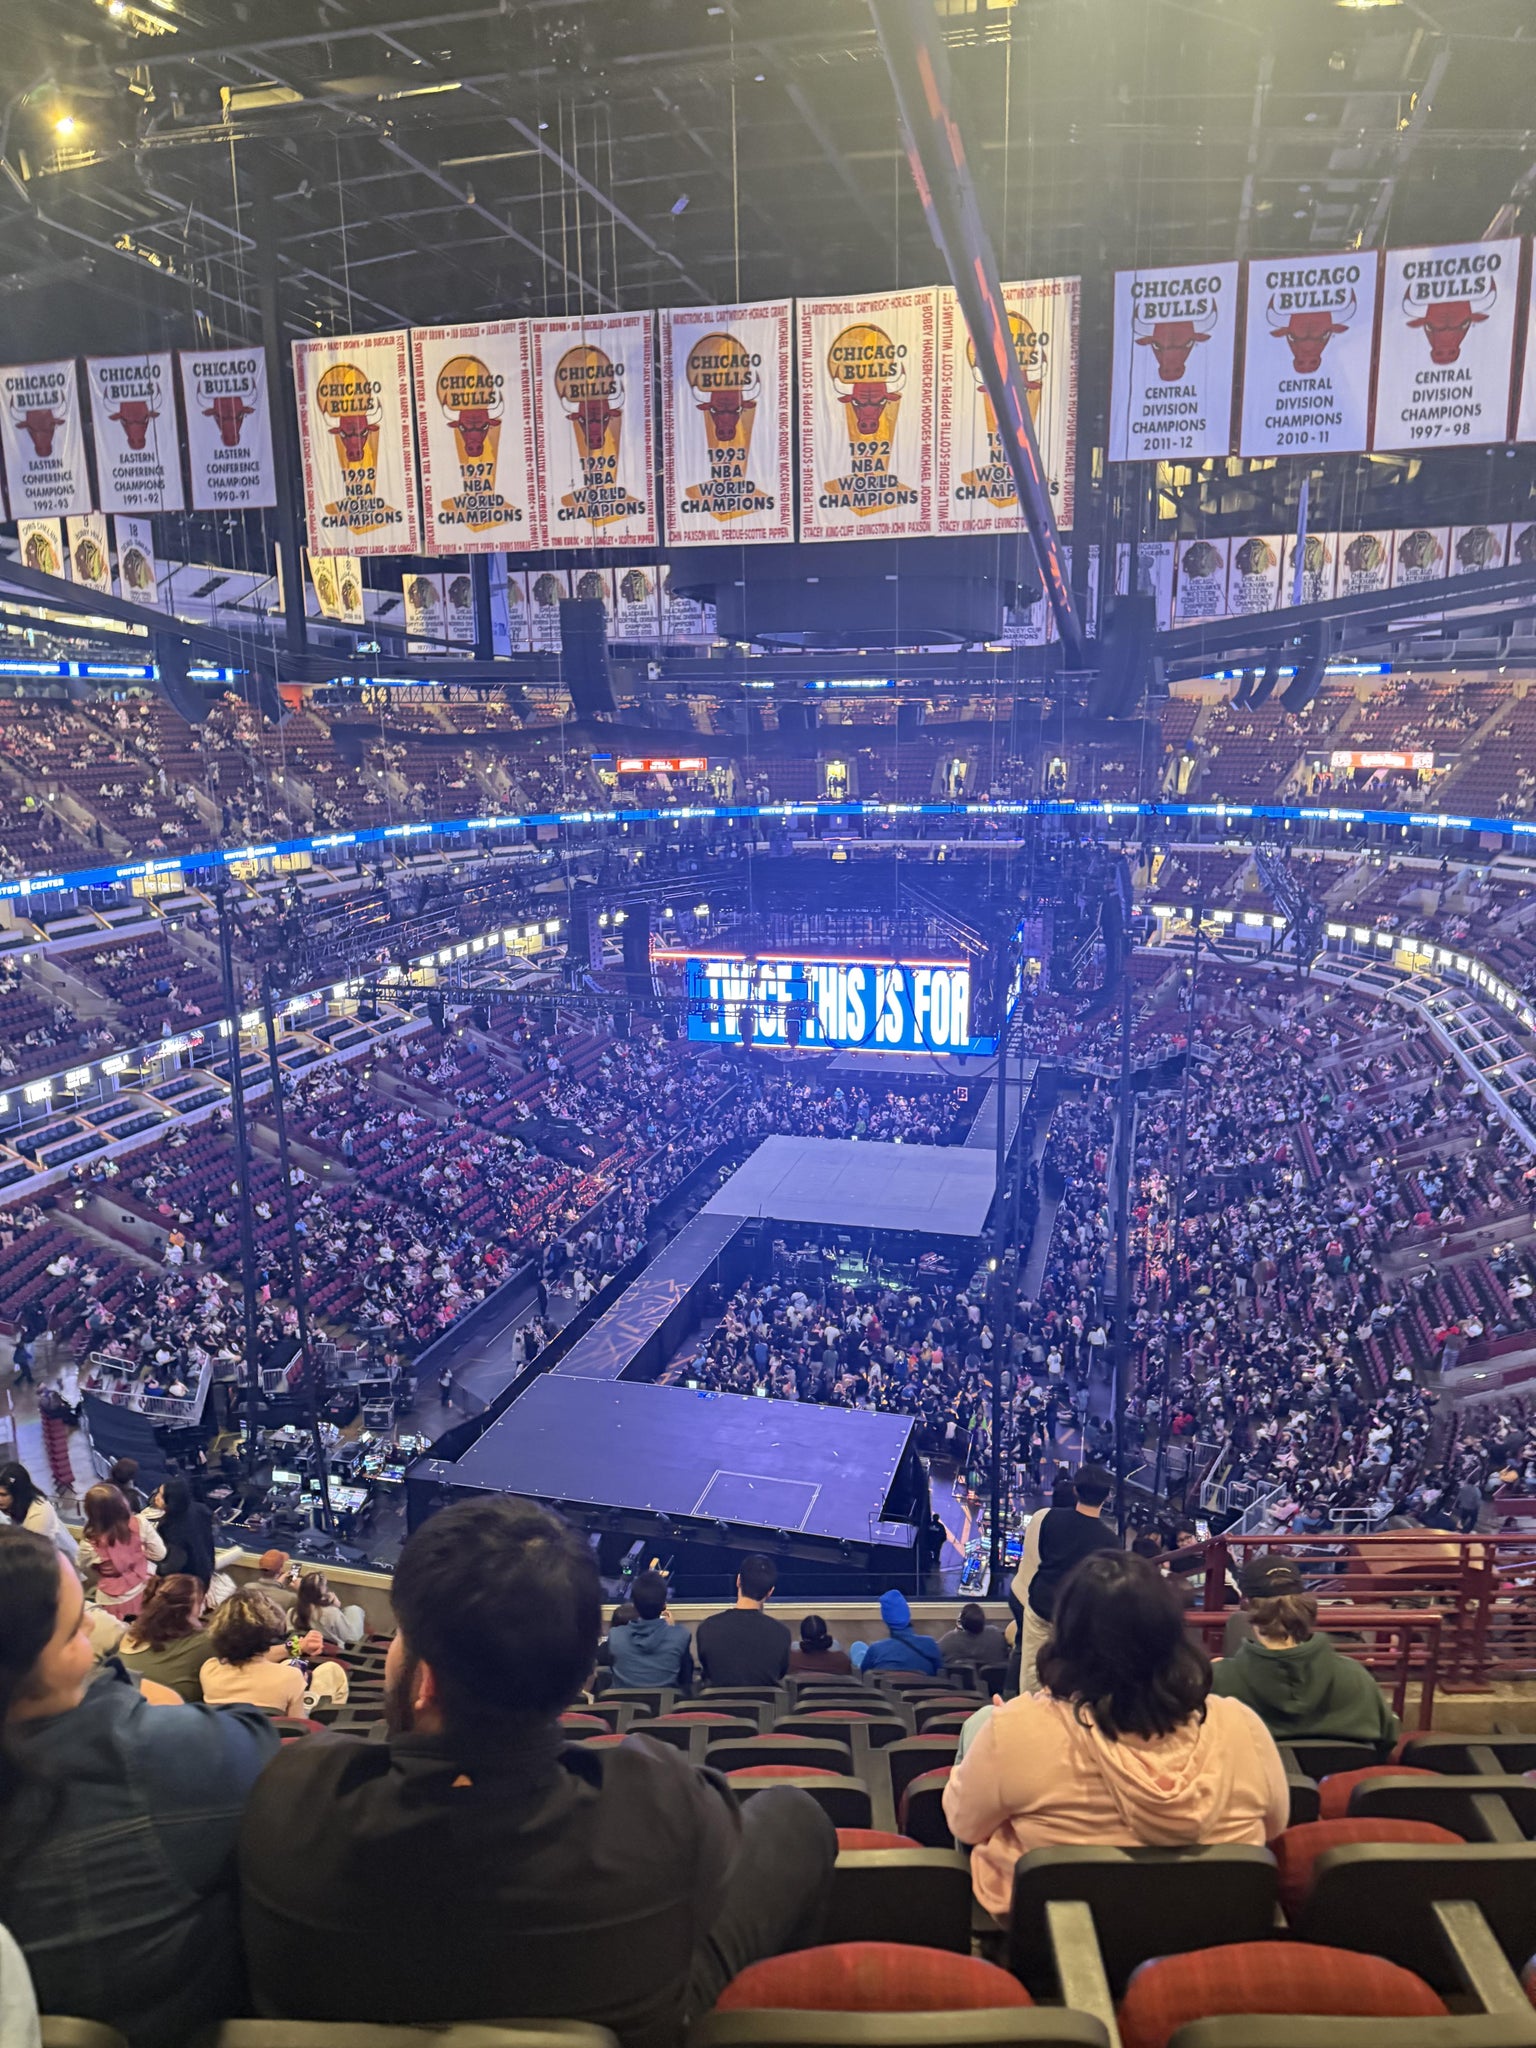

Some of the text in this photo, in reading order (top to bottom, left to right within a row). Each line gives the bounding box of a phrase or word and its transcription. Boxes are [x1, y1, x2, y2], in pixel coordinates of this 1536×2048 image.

[1402, 253, 1502, 280] CHICAGO
[1266, 266, 1360, 290] CHICAGO
[1131, 276, 1222, 298] CHICAGO
[1416, 277, 1486, 301] BULLS
[1279, 288, 1346, 310] BULLS
[1144, 298, 1209, 321] BULLS
[832, 344, 908, 362] CHICAGO
[193, 360, 256, 377] CHICAGO
[690, 354, 762, 370] CHICAGO
[100, 365, 160, 382] CHICAGO
[558, 363, 625, 381] CHICAGO
[844, 362, 898, 380] BULLS
[1415, 367, 1472, 384] CENTRAL
[6, 372, 65, 390] CHICAGO
[204, 378, 249, 394] BULLS
[440, 375, 504, 390] CHICAGO
[702, 372, 752, 388] BULLS
[1278, 377, 1333, 393] CENTRAL
[110, 383, 154, 399] BULLS
[320, 381, 382, 398] CHICAGO
[570, 380, 618, 398] BULLS
[1145, 385, 1198, 400] CENTRAL
[1412, 386, 1474, 403] DIVISION
[18, 390, 58, 408] BULLS
[330, 398, 374, 414] BULLS
[451, 392, 496, 407] BULLS
[1275, 395, 1334, 411] DIVISION
[1142, 402, 1198, 417] DIVISION
[1400, 404, 1482, 422] CHAMPIONS
[1132, 418, 1206, 435] CHAMPIONS
[1265, 412, 1343, 430] CHAMPIONS
[1276, 430, 1330, 446] 2010-11
[1410, 423, 1470, 440] 1997-98
[849, 442, 890, 457] 1992
[1144, 436, 1193, 450] 2011-12
[120, 452, 155, 463] EASTERN
[214, 449, 250, 460] EASTERN
[707, 448, 746, 462] 1993
[29, 459, 63, 470] EASTERN
[206, 461, 260, 474] CONFERENCE
[460, 463, 494, 477] 1997
[580, 456, 616, 470] 1996
[711, 464, 742, 478] NBA
[851, 458, 885, 473] NBA
[22, 472, 72, 484] CONFERENCE
[112, 466, 164, 478] CONFERENCE
[341, 470, 376, 482] 1998
[584, 471, 614, 486] NBA
[114, 480, 165, 492] CHAMPIONS
[208, 476, 260, 488] CHAMPIONS
[346, 483, 373, 497] NBA
[464, 478, 492, 492] NBA
[700, 480, 755, 496] WORLD
[838, 474, 898, 491] WORLD
[25, 486, 75, 498] CHAMPIONS
[213, 490, 250, 502] 1990-91
[573, 487, 627, 503] WORLD
[818, 489, 918, 509] CHAMPIONS
[955, 481, 1060, 501] CHAMPS
[33, 499, 69, 511] 1992-93
[123, 494, 159, 505] 1991-92
[336, 498, 385, 512] WORLD
[454, 494, 504, 507] WORLD
[680, 496, 775, 514] CHAMPIONS
[322, 510, 403, 528] CHAMPIONS
[438, 508, 522, 525] CHAMPIONS
[558, 501, 646, 522] CHAMPIONS
[116, 861, 181, 876] UNITED CENTER
[31, 878, 64, 890] CENTER
[805, 965, 866, 1042] THIS
[876, 968, 904, 1043] IS
[912, 970, 970, 1046] FOR
